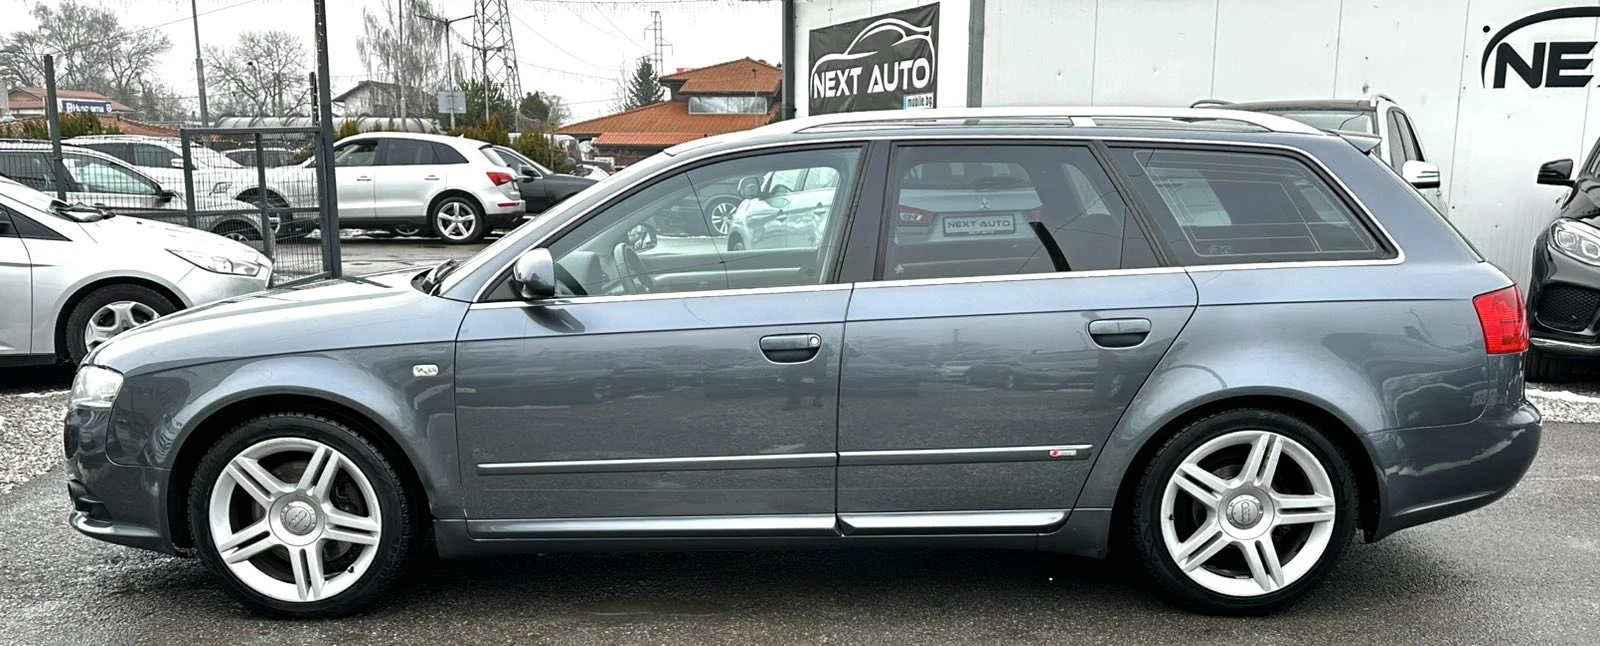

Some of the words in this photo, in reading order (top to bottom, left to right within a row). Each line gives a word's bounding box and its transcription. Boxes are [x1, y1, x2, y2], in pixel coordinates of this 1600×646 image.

[813, 67, 863, 99] NEXT
[867, 58, 930, 94] AUTO
[1493, 41, 1600, 89] NE
[907, 95, 932, 108] mobile.bg
[947, 220, 976, 229] NEXT
[980, 219, 1010, 228] AUTO
